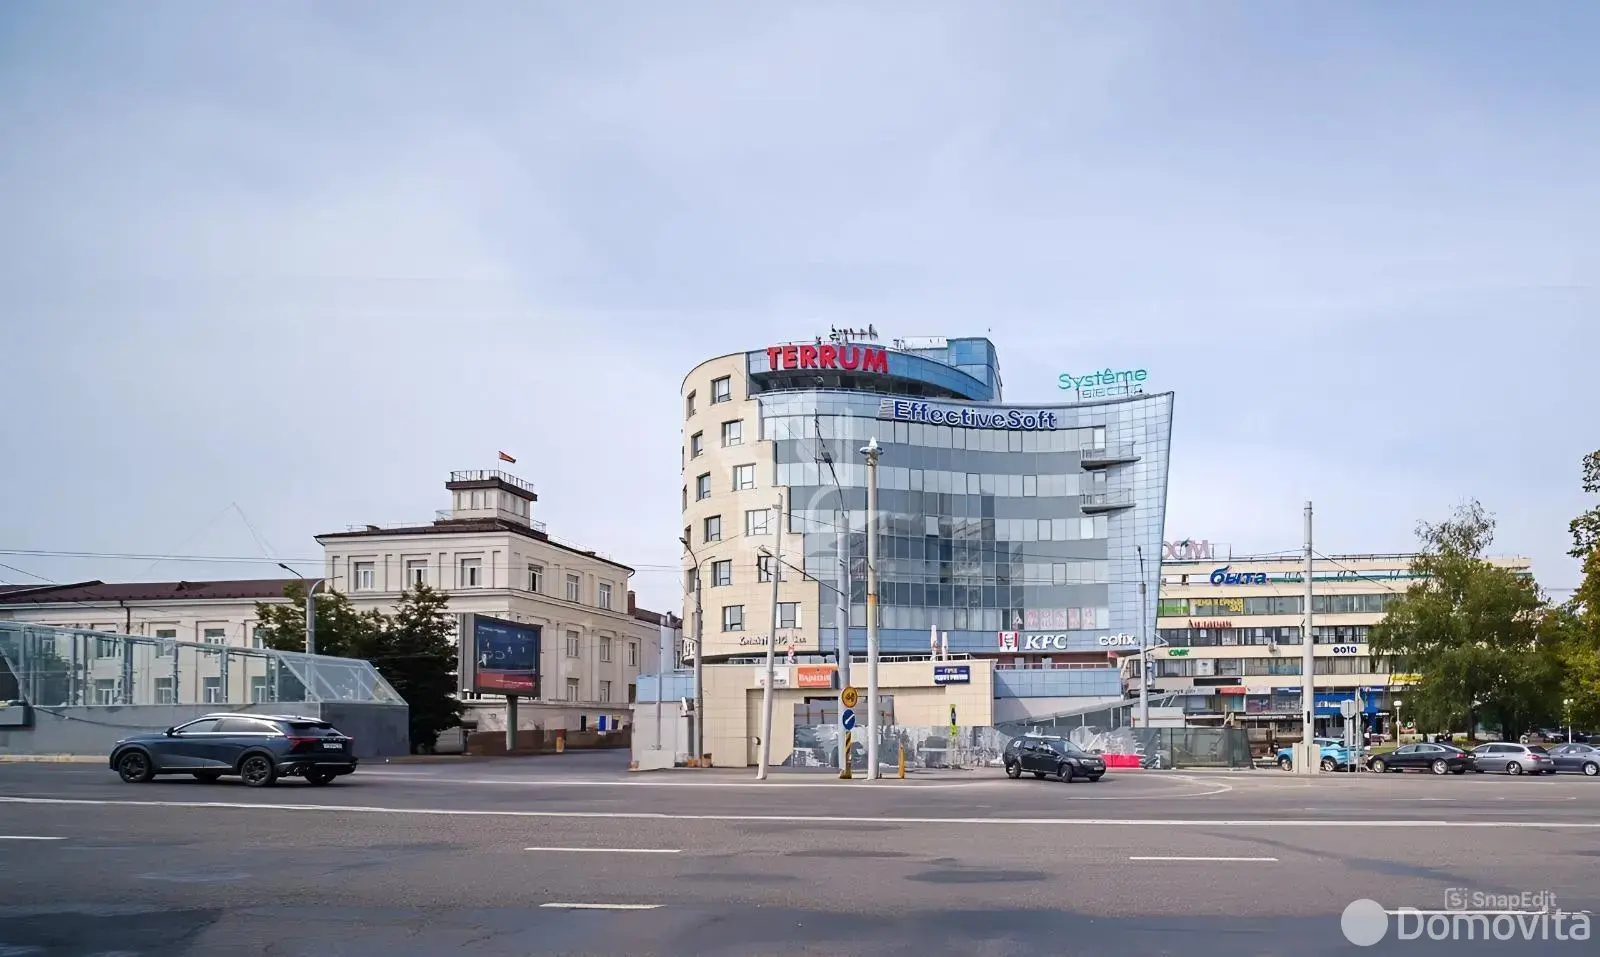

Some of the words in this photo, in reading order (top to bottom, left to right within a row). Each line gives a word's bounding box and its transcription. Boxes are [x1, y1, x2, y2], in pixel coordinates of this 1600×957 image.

[767, 344, 888, 374] TERRUM
[894, 400, 1057, 429] EffectiveSoft
[1210, 565, 1267, 585] быта
[1024, 635, 1067, 650] KFC
[1100, 633, 1136, 646] cofix
